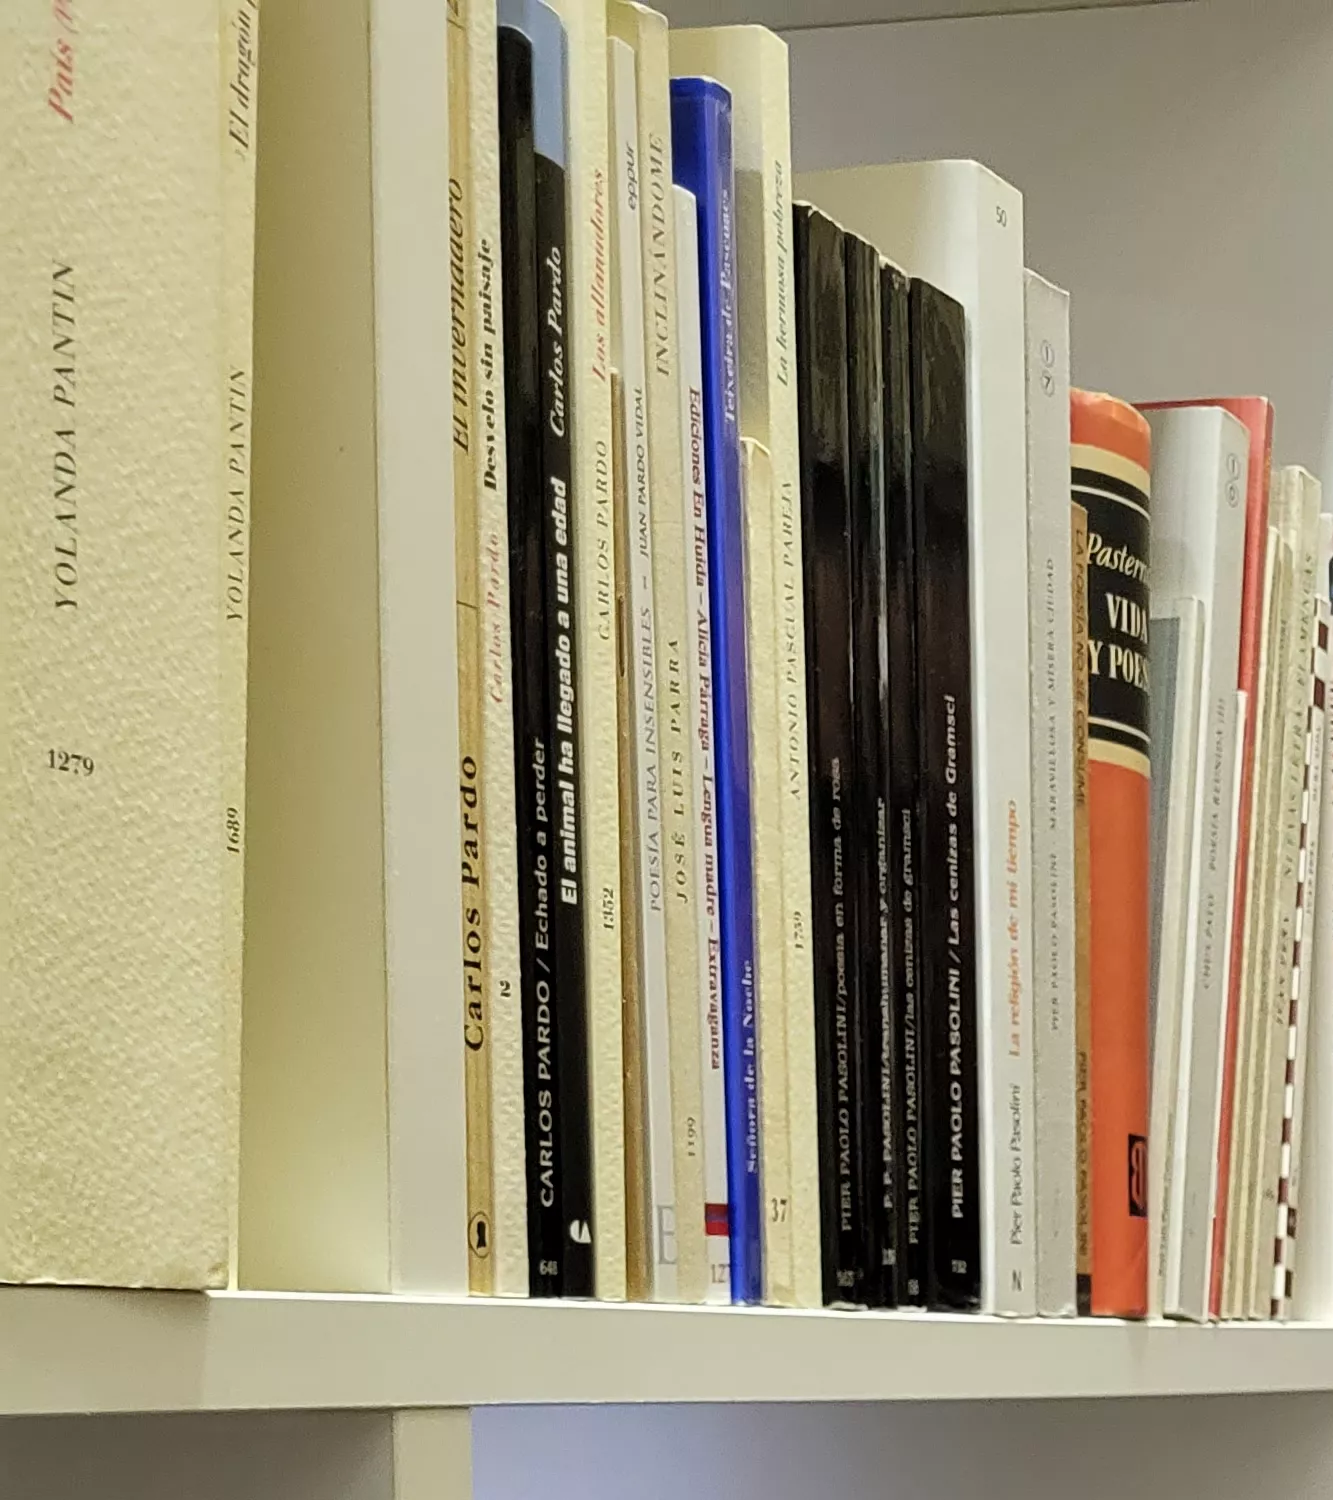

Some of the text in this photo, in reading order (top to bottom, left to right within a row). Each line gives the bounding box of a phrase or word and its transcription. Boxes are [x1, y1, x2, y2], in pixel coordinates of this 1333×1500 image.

[229, 8, 257, 147] El dragón
[546, 245, 565, 438] Carlos Pardo
[649, 132, 670, 378] INCLINÁNDOME
[51, 257, 78, 612] YOLANDA PANTIN
[479, 240, 497, 493] Desvelo sin paisaje
[227, 362, 247, 622] YOLANDA PANTIN
[595, 439, 610, 641] CARLOS PARDO
[634, 386, 649, 559] JUAN PARDO VIDAL
[550, 478, 578, 906] El animal ha llegado a una edad
[1105, 592, 1149, 645] VIDA
[48, 749, 95, 777] 1279
[225, 807, 241, 854] 1689
[533, 736, 549, 823] perder
[642, 606, 661, 913] POESÍA PARA INSENSIBLES
[668, 636, 688, 903] JOSÉ LUIS PARRA
[460, 756, 484, 1053] Carlos Pardo
[535, 855, 549, 951] Echado
[943, 694, 964, 1219] PIER PAOLO PASOLINI Las cenizas de Gramsci
[538, 981, 552, 1081] PARDO
[539, 1091, 554, 1207] CARLOS
